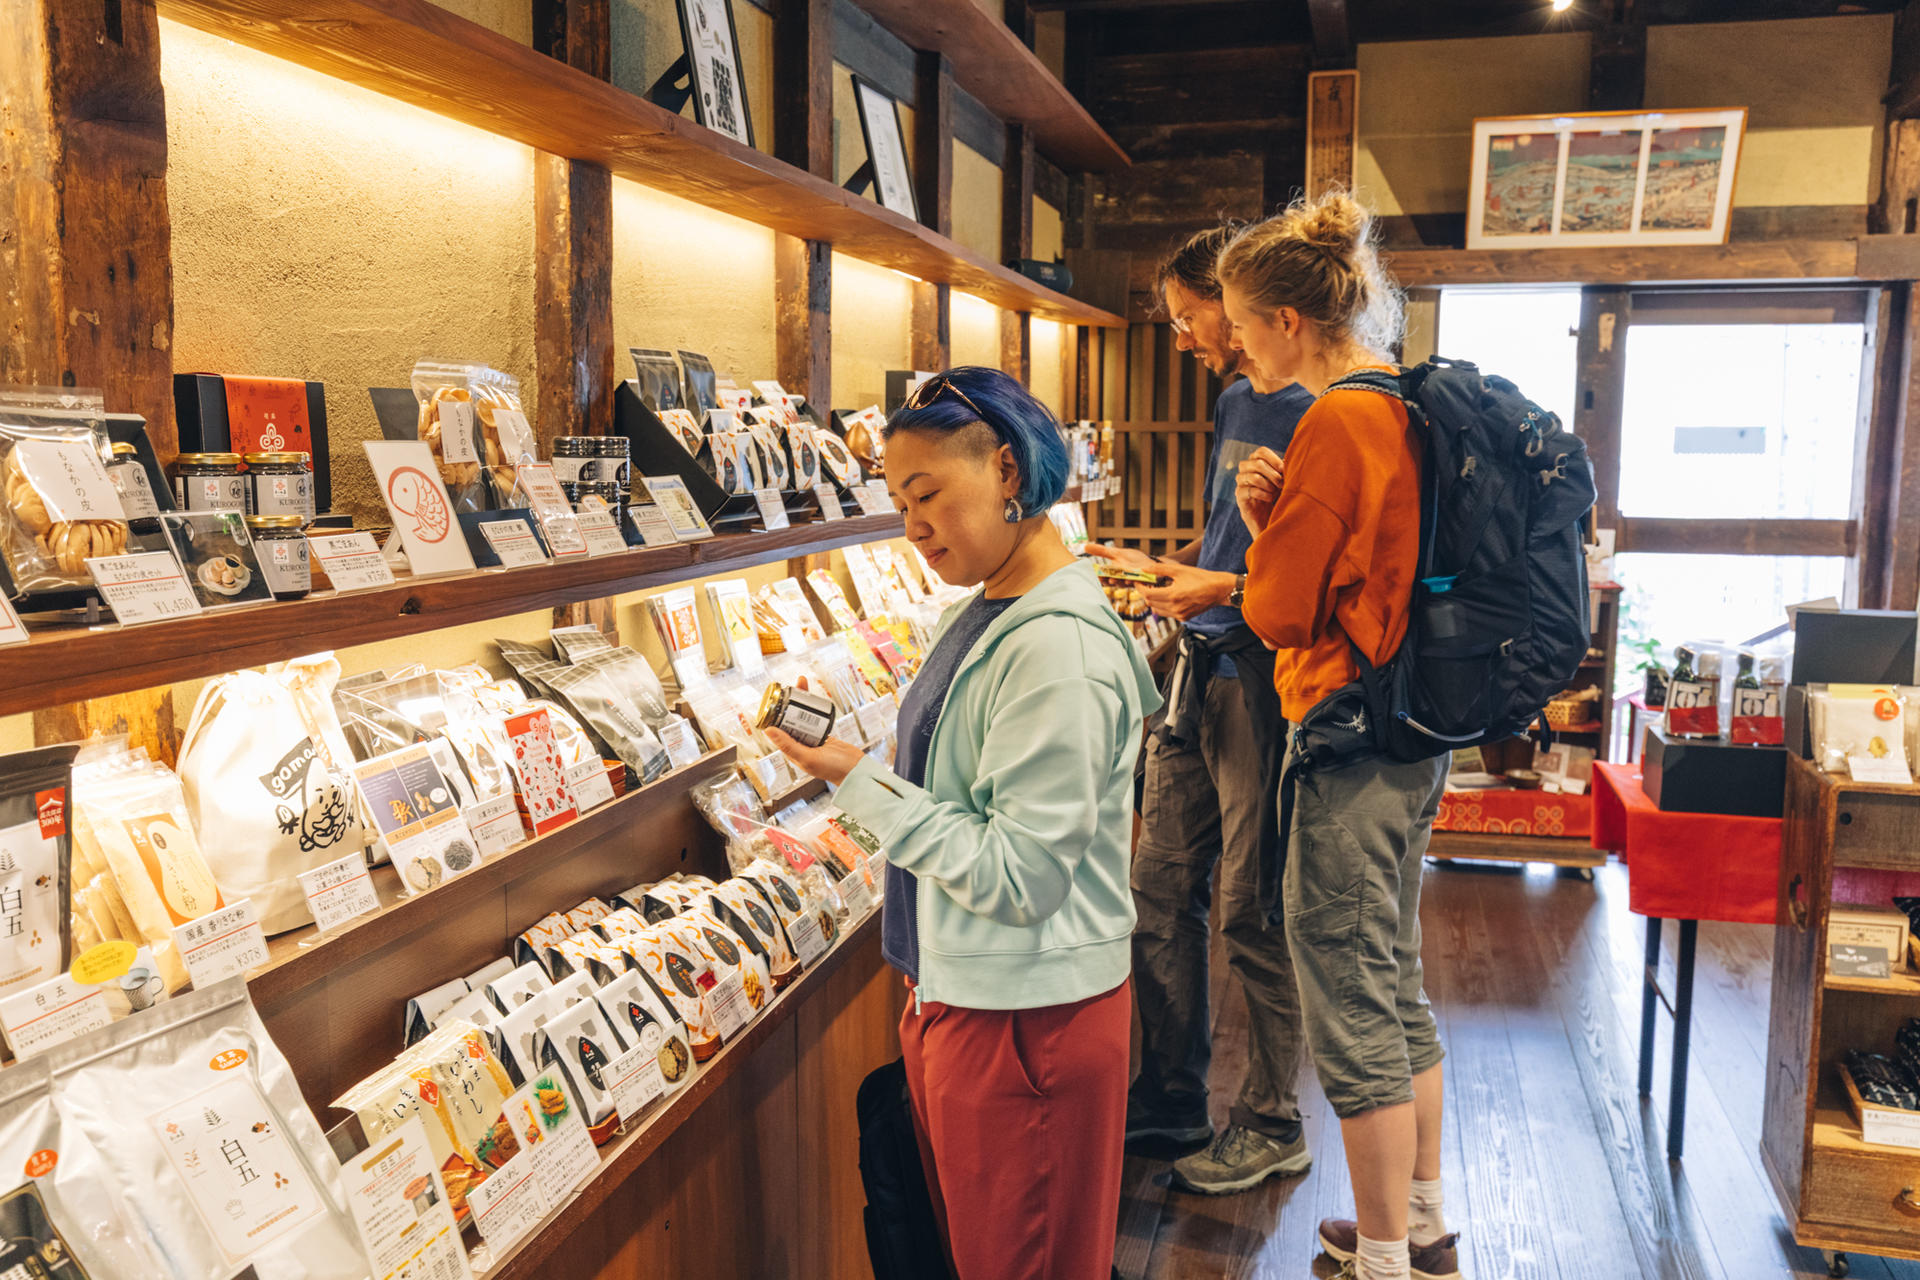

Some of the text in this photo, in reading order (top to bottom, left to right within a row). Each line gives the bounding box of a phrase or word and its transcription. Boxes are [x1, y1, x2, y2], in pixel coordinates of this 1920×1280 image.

[57, 448, 94, 512] もなかの皮
[153, 598, 194, 614] ¥1,450
[272, 748, 317, 794] goma
[41, 815, 62, 827] 300年
[0, 886, 24, 938] 白五
[185, 924, 205, 941] 国産
[235, 946, 262, 967] ¥378
[220, 1139, 261, 1187] 白五
